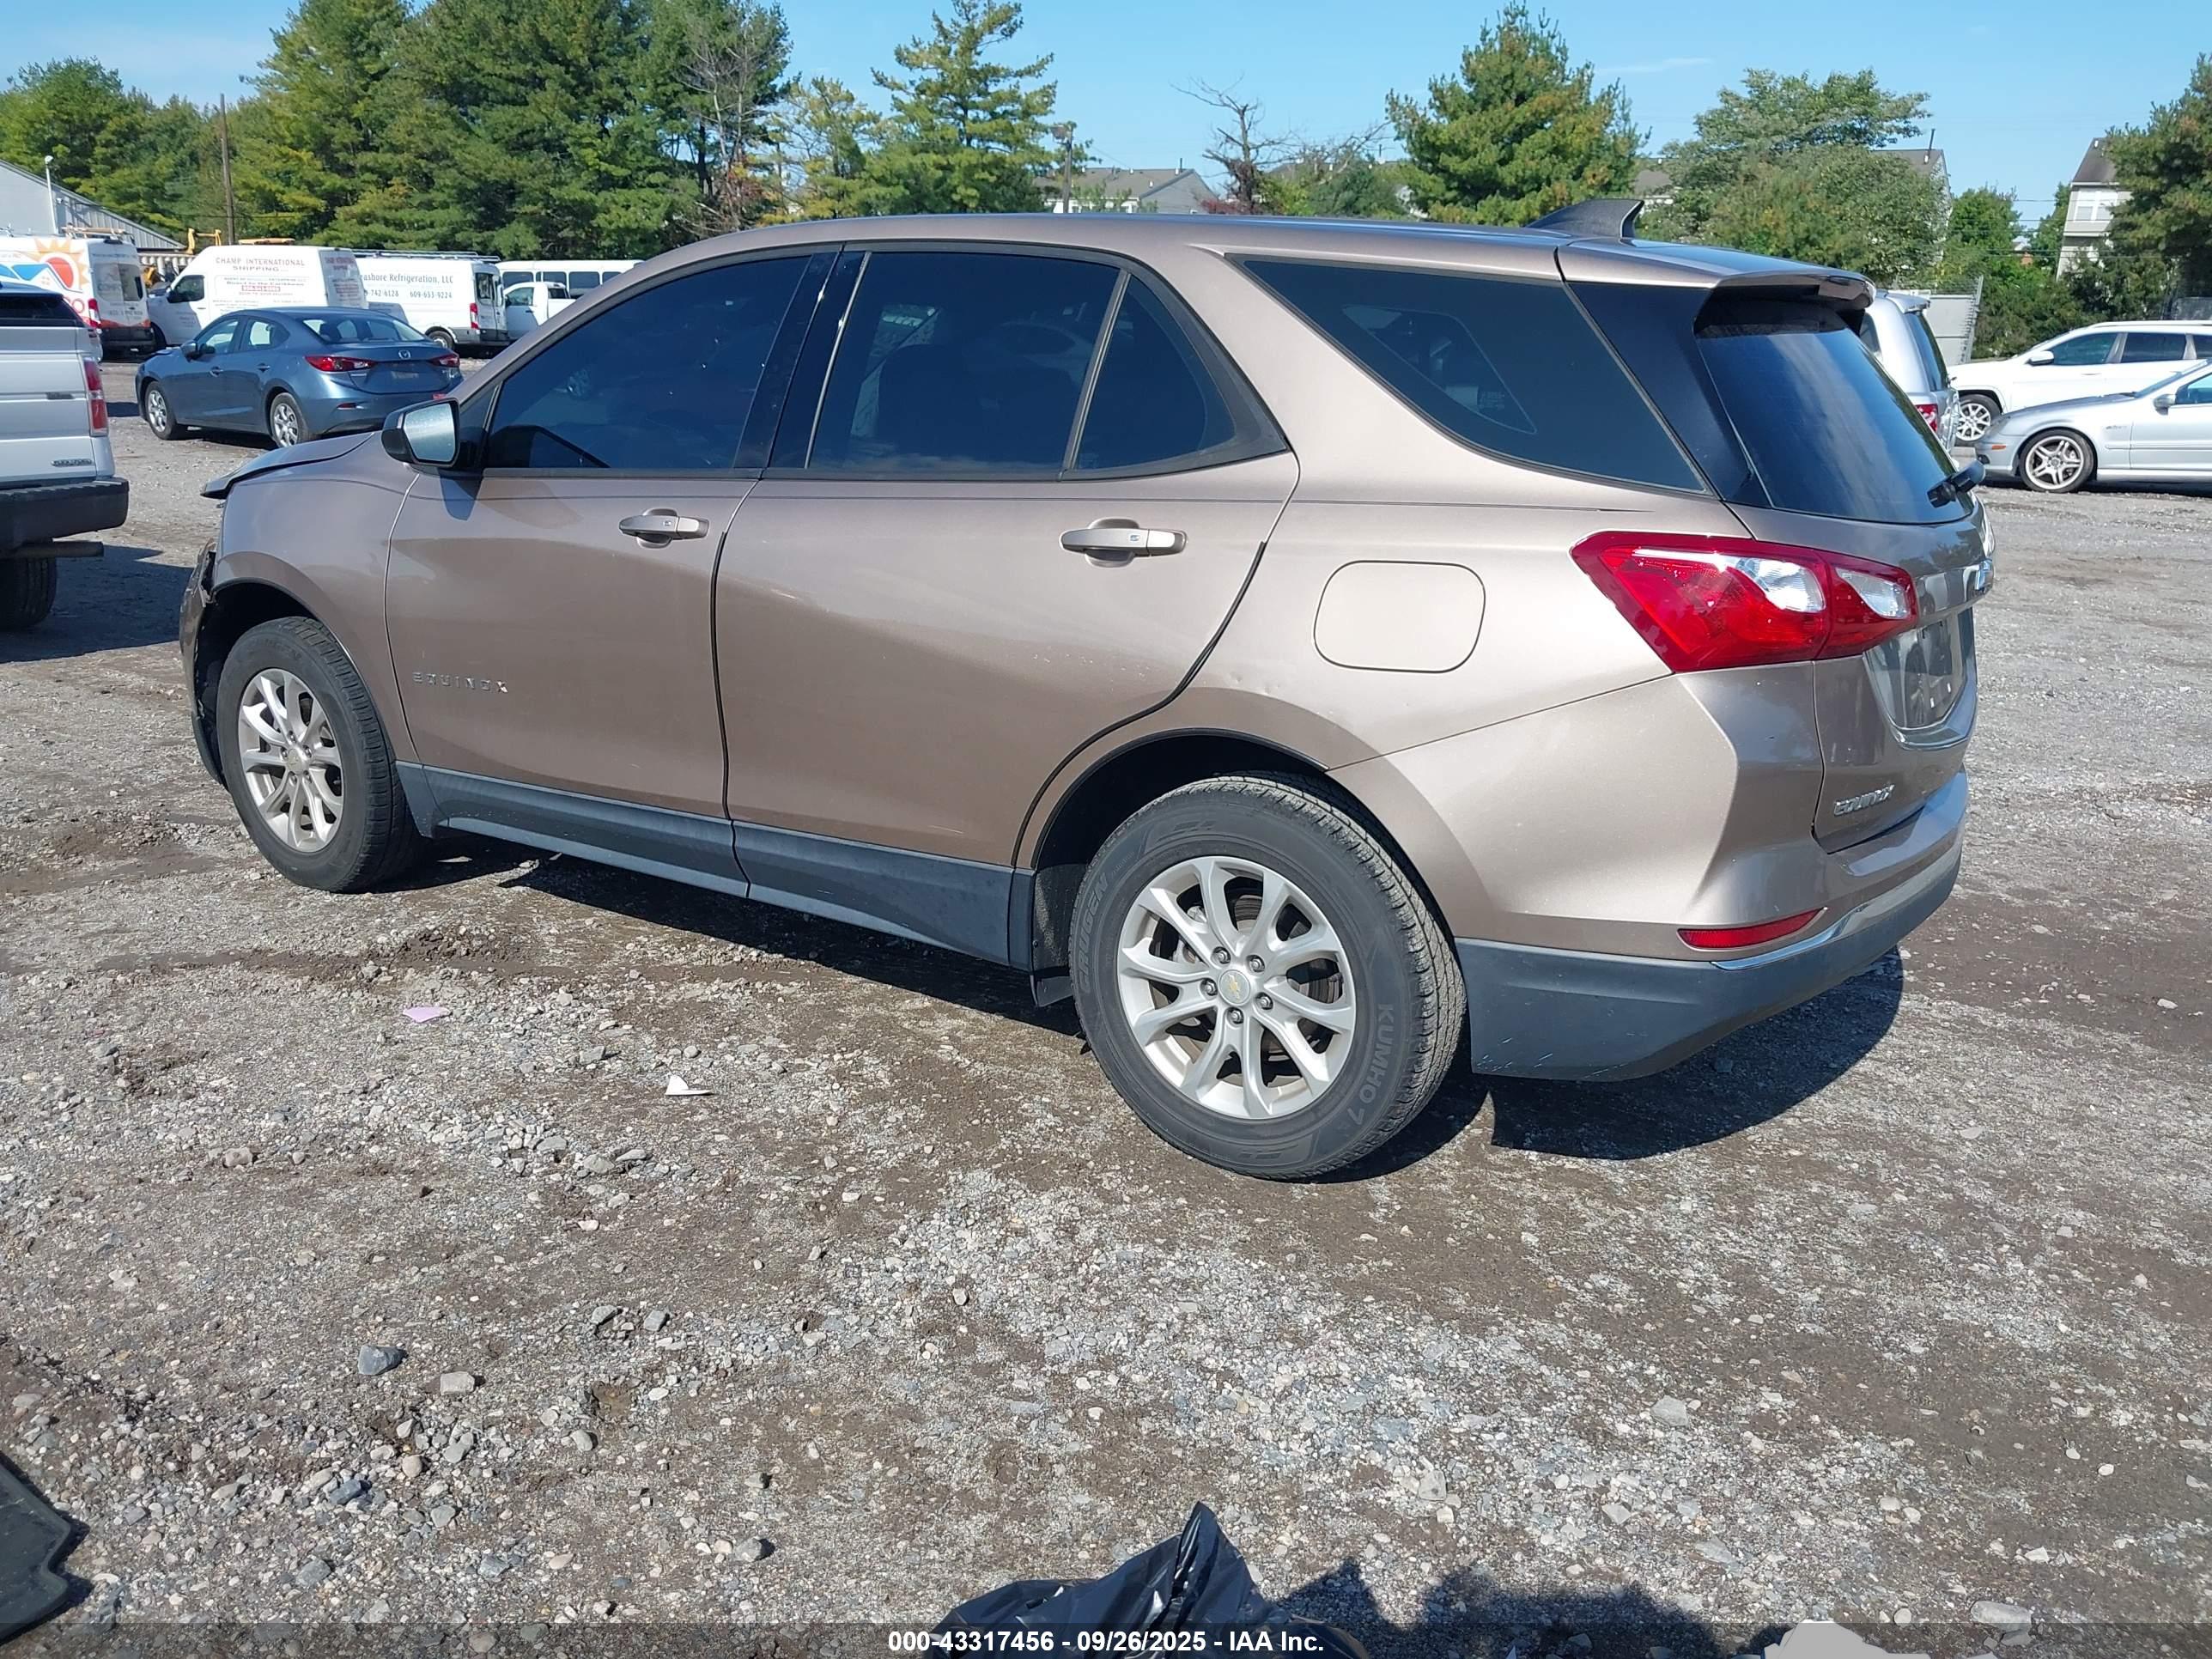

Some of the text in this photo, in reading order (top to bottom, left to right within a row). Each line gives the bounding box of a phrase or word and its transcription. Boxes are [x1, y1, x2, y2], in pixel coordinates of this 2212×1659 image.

[246, 258, 305, 266] INTERNATIONAL
[389, 273, 440, 285] Refrigeration,
[441, 275, 453, 283] LLC
[412, 671, 508, 694] EQUINOX
